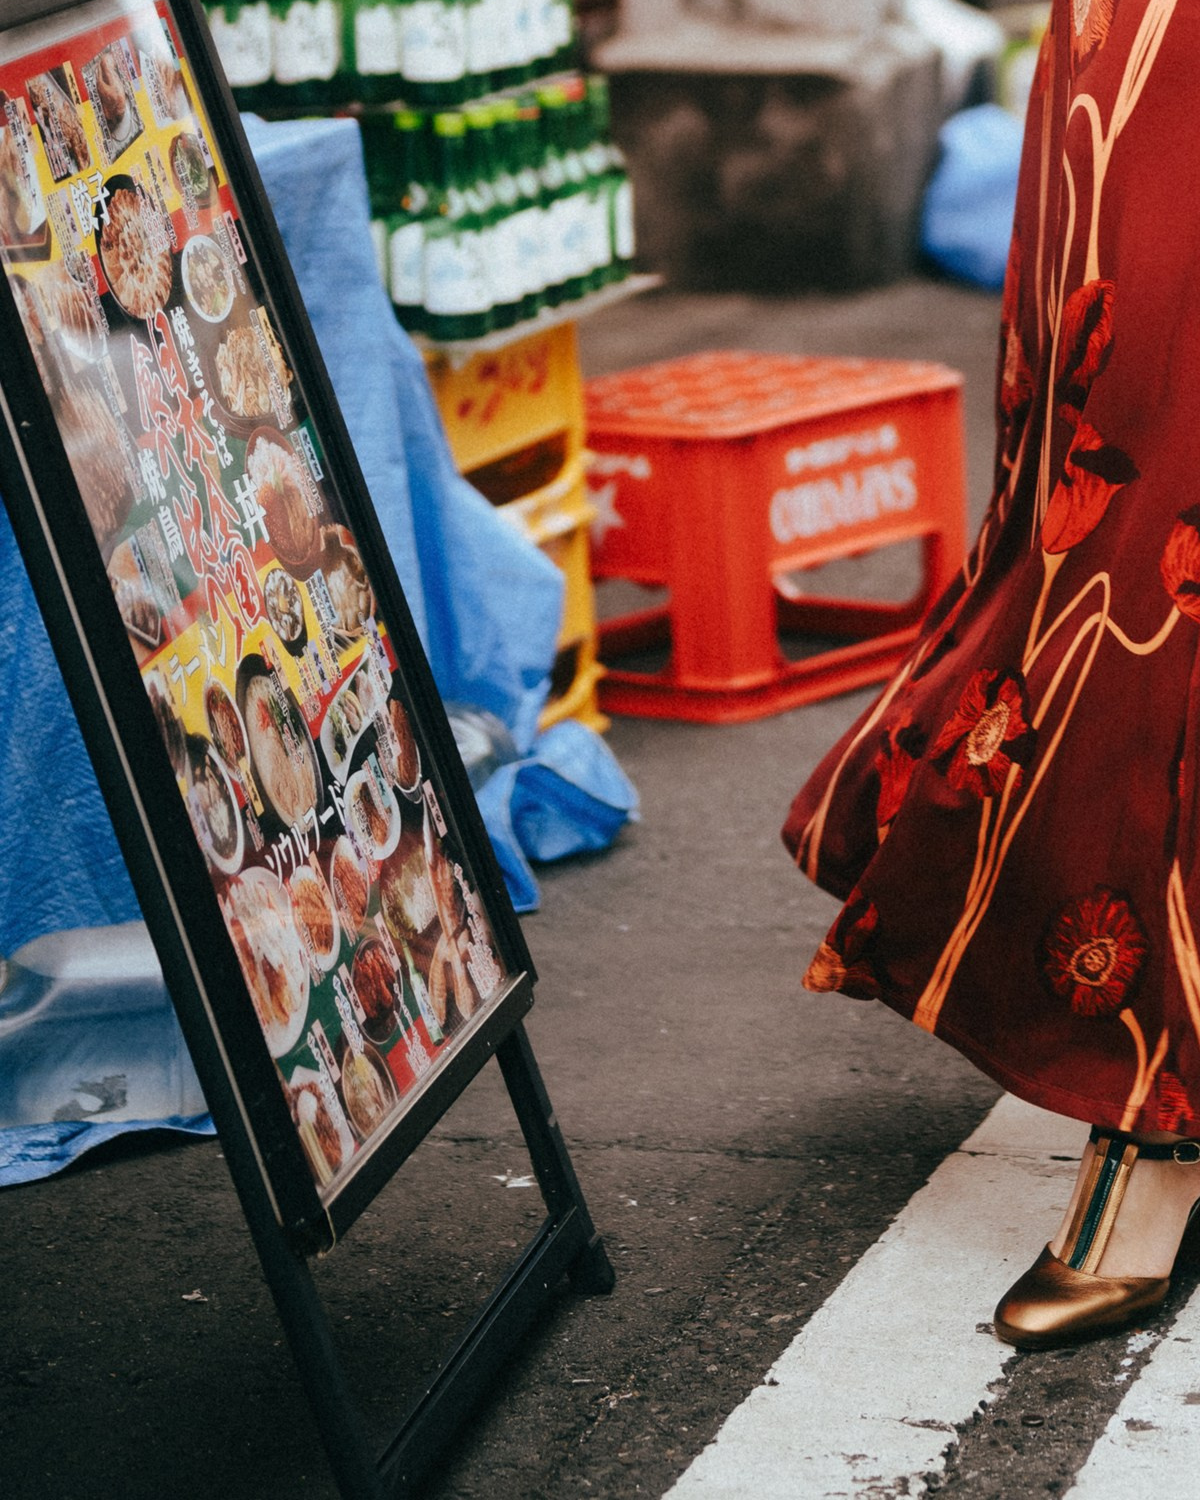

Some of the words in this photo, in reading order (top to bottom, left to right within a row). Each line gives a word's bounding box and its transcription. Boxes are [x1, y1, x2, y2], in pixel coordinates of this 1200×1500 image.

[69, 169, 111, 237] 餃子
[169, 305, 234, 470] 焼きそば
[129, 333, 242, 662] 食べ比べ
[136, 446, 185, 563] 焼鳥
[141, 309, 271, 630] 日本全国
[233, 472, 271, 551] 丼
[167, 624, 224, 704] ラーメン
[263, 781, 345, 890] ソウルフード
